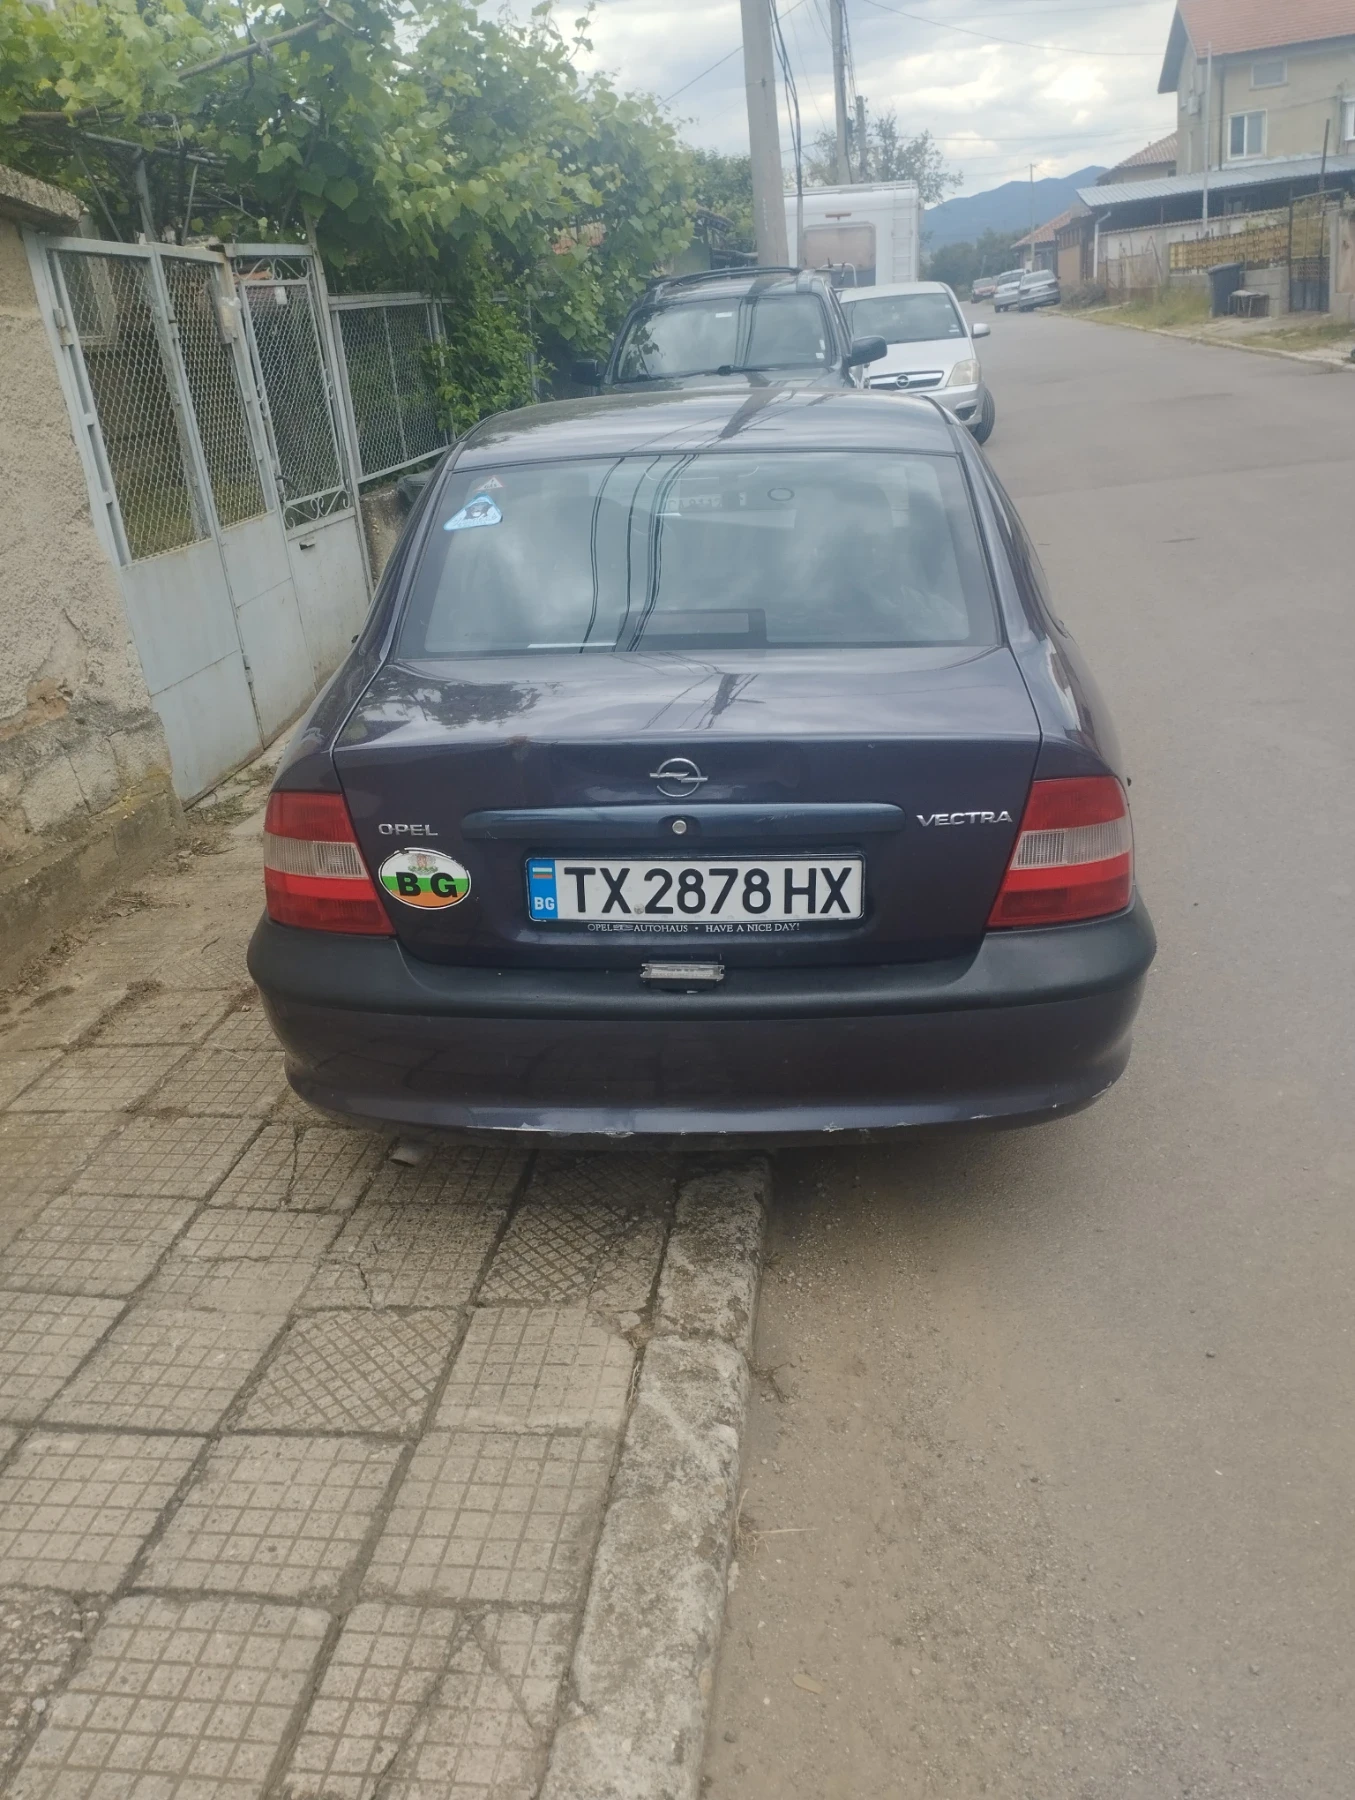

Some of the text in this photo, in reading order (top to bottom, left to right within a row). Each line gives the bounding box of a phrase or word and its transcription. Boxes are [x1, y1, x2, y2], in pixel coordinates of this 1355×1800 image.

[916, 810, 1013, 827] VECTRA
[378, 823, 439, 836] OPEL
[564, 867, 852, 914] TX 2878 HX
[534, 896, 555, 911] BG
[587, 922, 800, 933] OPEL AUTOHAUS HAVE A NICE DAY!
